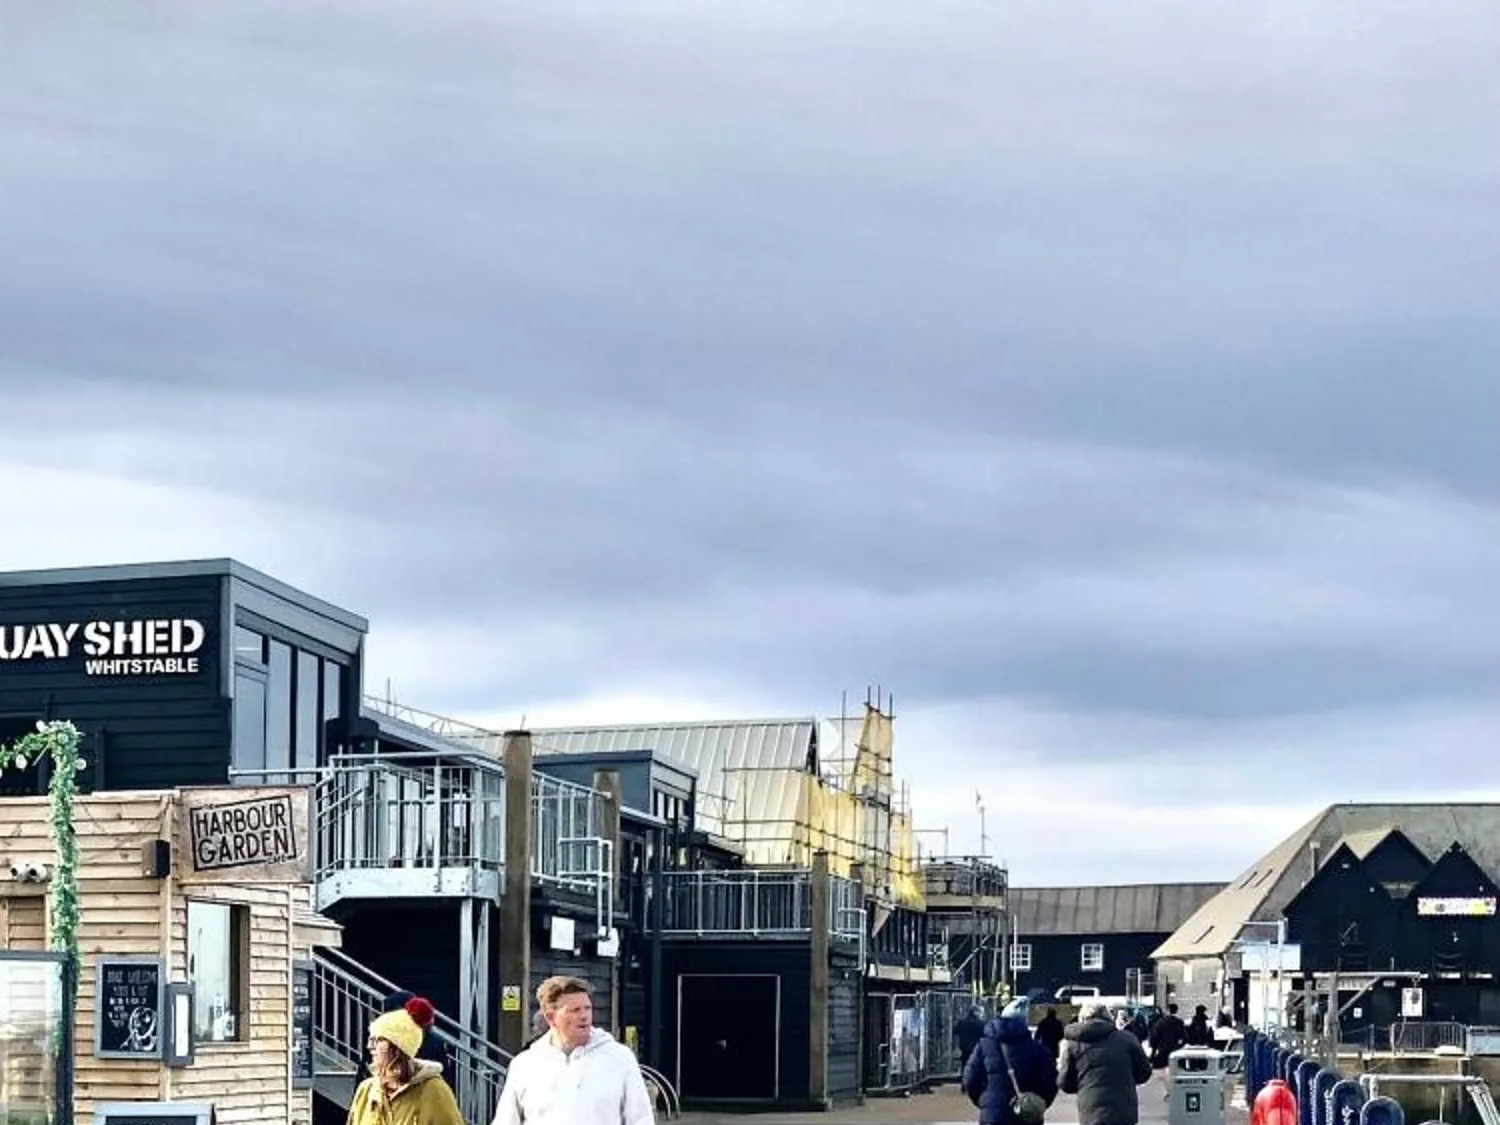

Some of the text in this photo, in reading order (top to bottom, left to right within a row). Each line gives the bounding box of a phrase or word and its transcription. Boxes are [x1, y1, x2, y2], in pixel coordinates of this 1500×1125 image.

[83, 619, 205, 656] SHED
[86, 657, 199, 675] WHITSTABLE
[195, 803, 287, 839] HARBOUR
[199, 828, 289, 863] GARDEN
